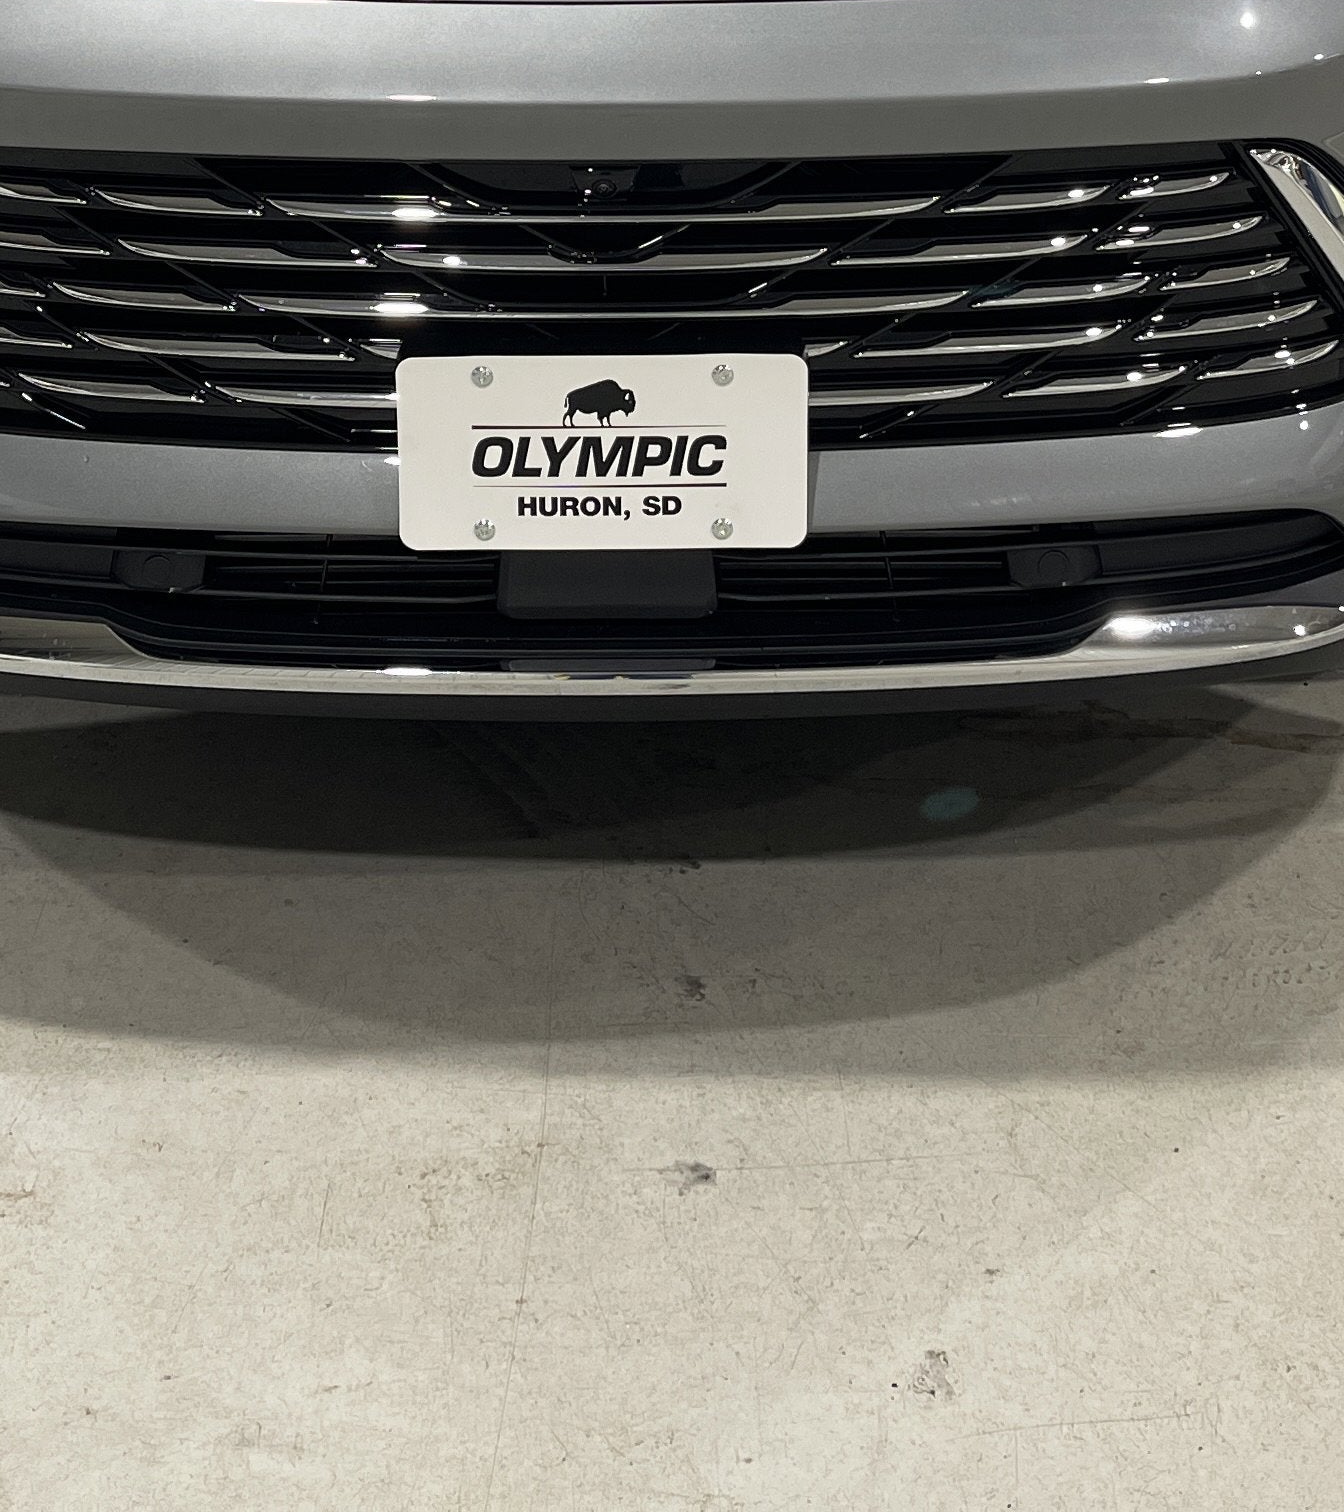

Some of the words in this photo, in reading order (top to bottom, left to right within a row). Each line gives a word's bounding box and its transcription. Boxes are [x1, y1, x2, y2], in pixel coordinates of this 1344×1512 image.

[472, 434, 728, 478] OLYMPIC
[517, 496, 631, 521] HURON,
[642, 495, 683, 516] SD
